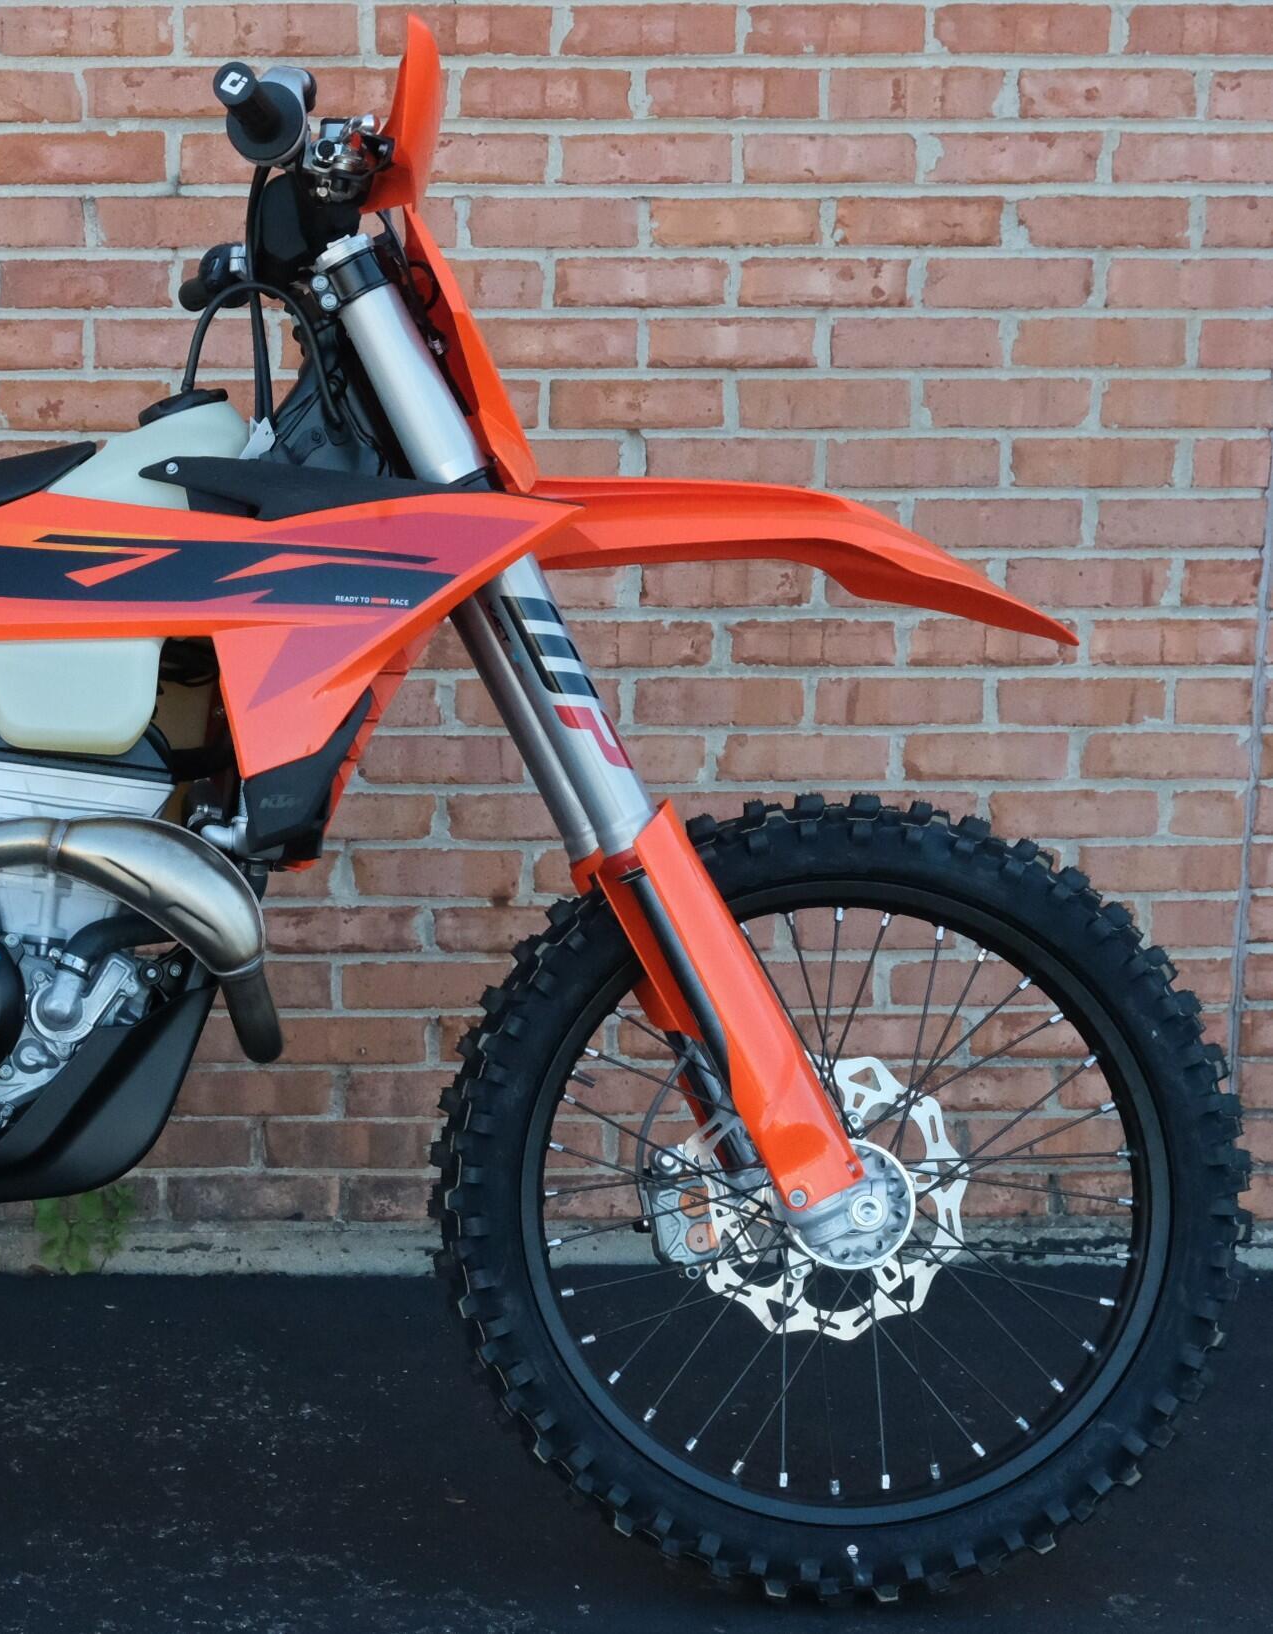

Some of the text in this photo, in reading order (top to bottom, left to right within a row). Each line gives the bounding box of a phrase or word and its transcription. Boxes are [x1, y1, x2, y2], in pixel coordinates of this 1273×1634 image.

[335, 595, 409, 606] READY TO RACE
